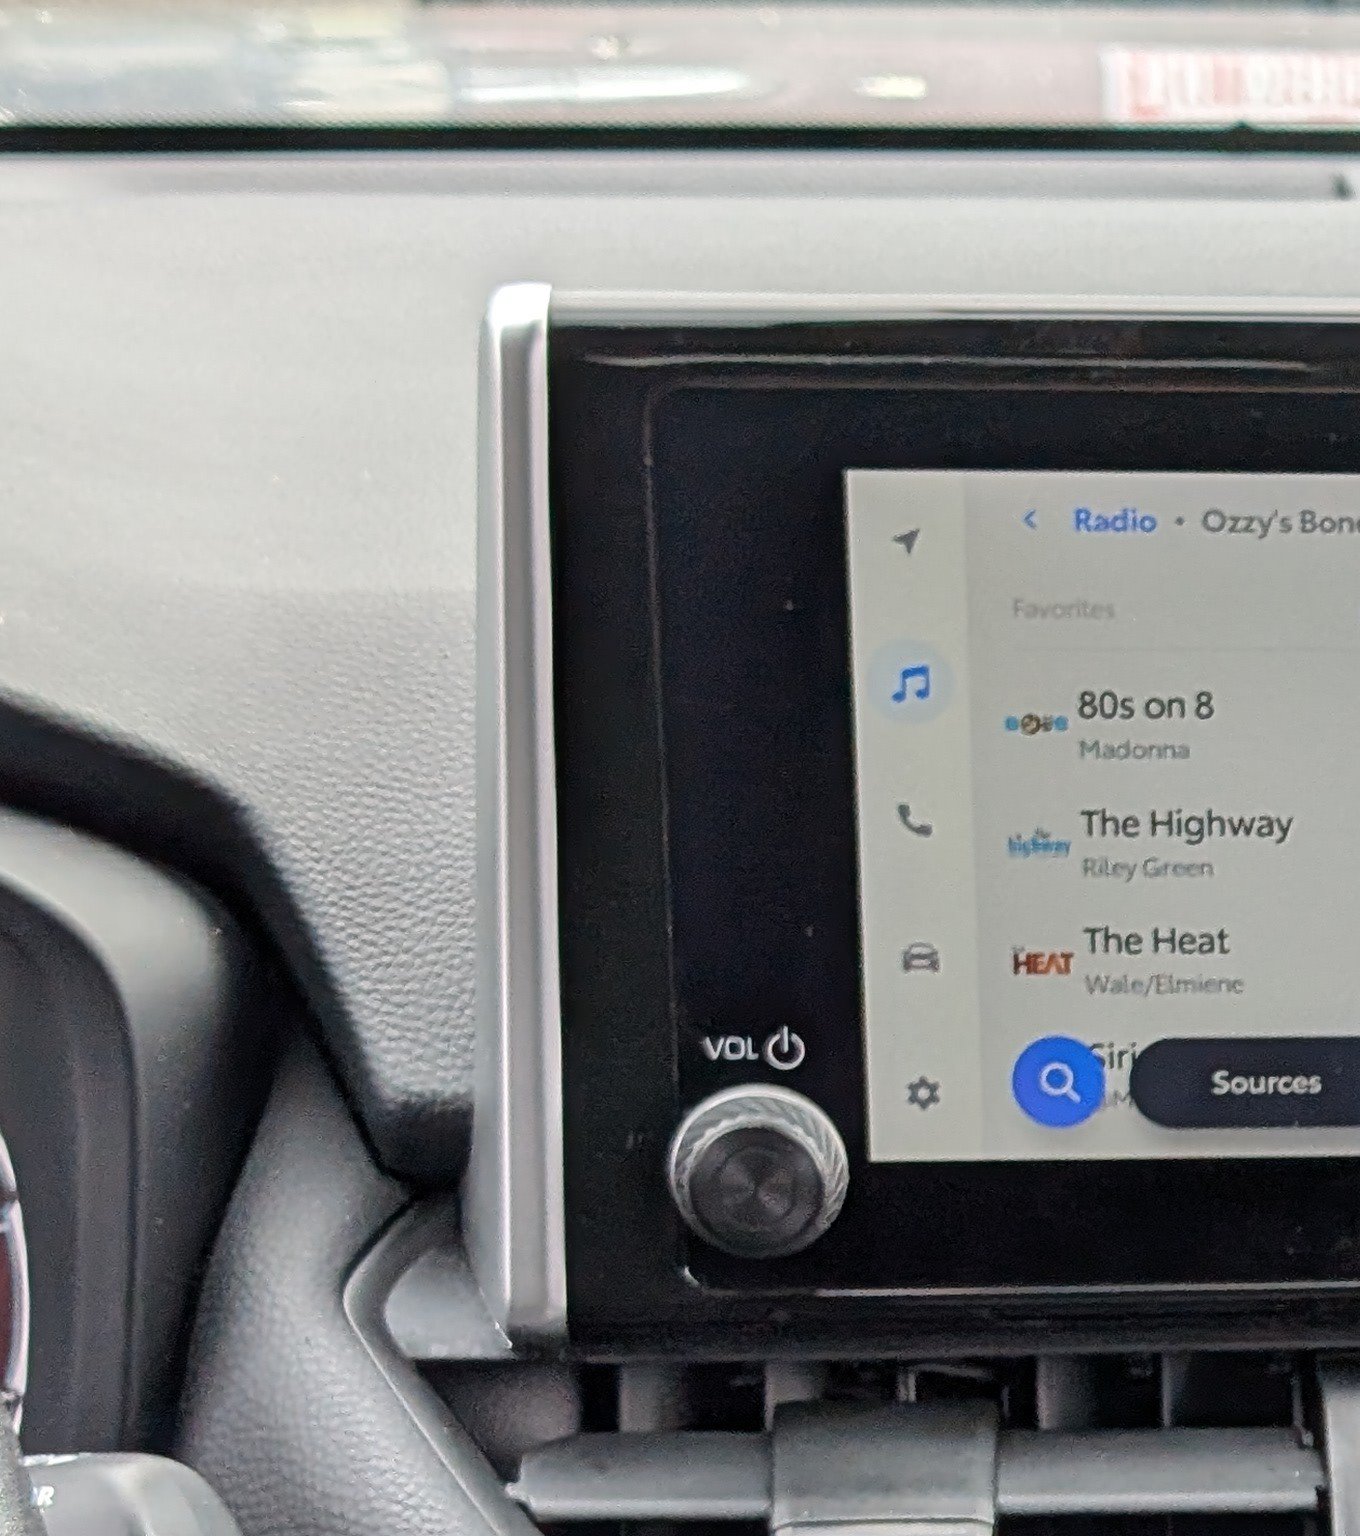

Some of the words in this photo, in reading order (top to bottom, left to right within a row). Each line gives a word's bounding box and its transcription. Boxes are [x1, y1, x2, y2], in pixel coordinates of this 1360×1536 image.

[1074, 508, 1157, 532] Radio
[1202, 509, 1292, 539] Ozzy's
[1013, 600, 1116, 620] Favorites
[1078, 691, 1135, 720] 80s
[1145, 697, 1185, 720] on
[1195, 691, 1215, 720] 8
[1079, 740, 1190, 760] Madonna
[1081, 810, 1140, 838] The
[1150, 810, 1294, 845] Highway
[1083, 858, 1137, 882] Riley
[1143, 858, 1214, 878] Green
[1083, 926, 1143, 955] The
[1153, 926, 1231, 954] Heat
[1013, 953, 1074, 975] HEAT
[702, 1036, 759, 1061] VOL
[1211, 1071, 1322, 1095] Sources
